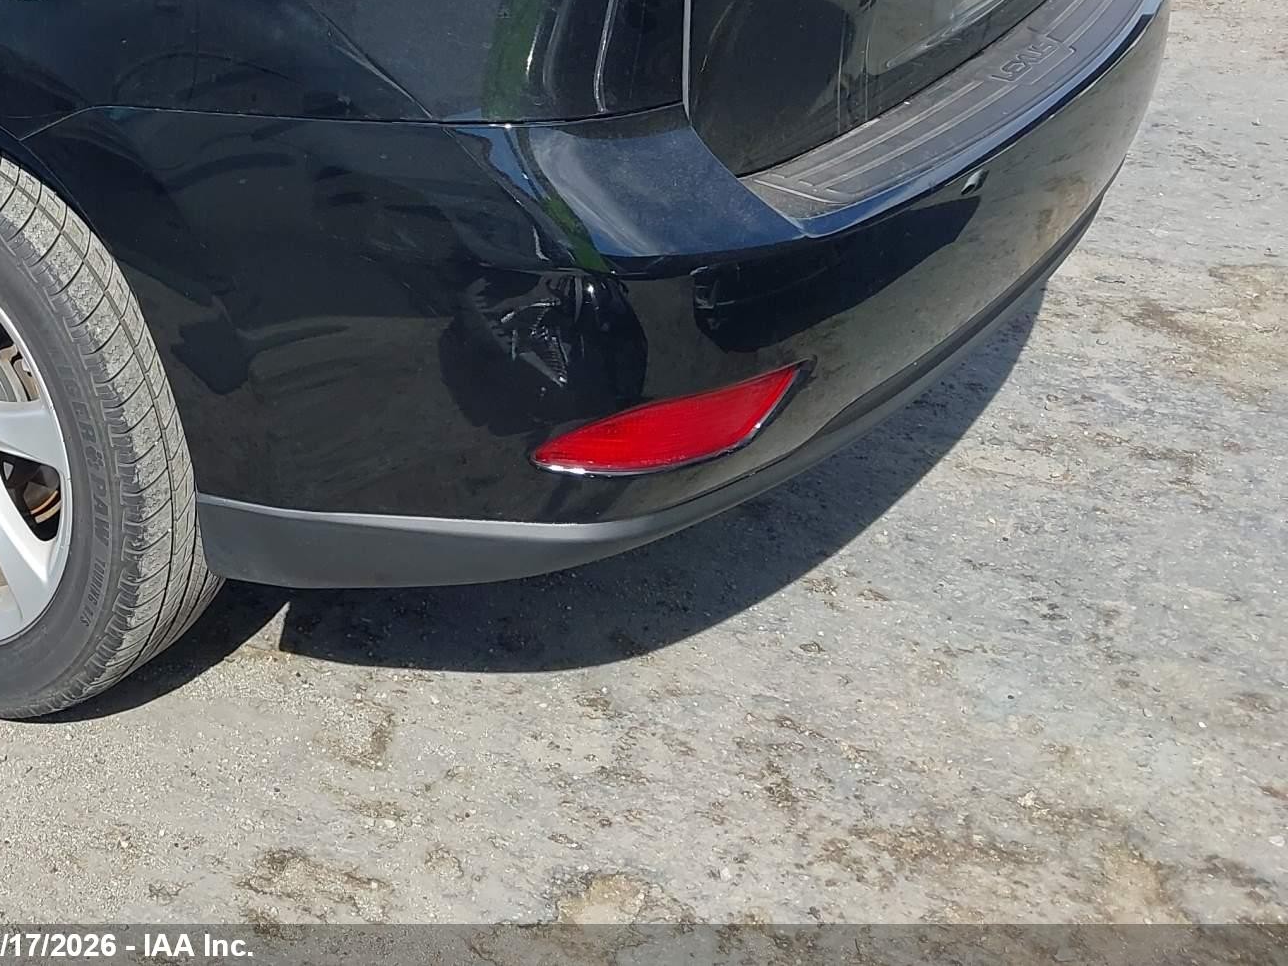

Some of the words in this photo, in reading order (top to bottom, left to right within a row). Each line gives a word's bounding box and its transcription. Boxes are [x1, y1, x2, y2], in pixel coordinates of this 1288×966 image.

[990, 43, 1058, 82] LEXUS
[89, 471, 111, 548] PAW
[86, 556, 106, 606] TOURING
